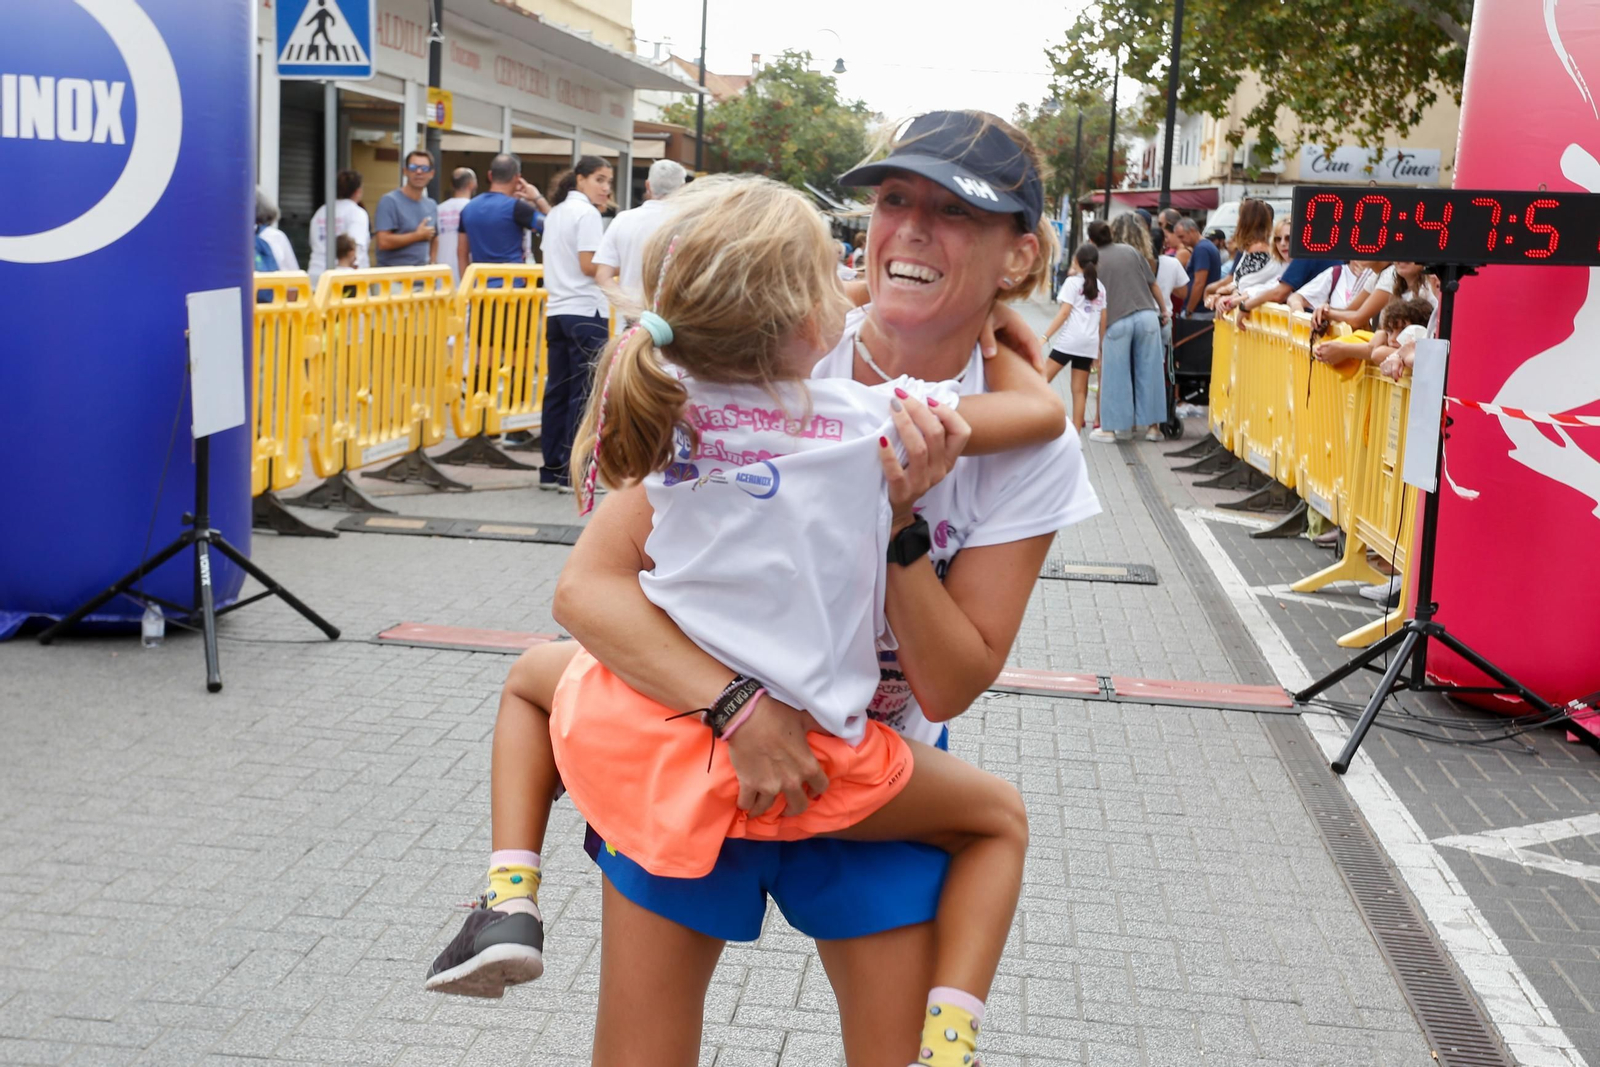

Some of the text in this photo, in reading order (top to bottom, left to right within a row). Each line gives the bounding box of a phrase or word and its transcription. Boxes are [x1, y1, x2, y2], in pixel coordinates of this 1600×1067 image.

[1, 73, 126, 145] INOX
[1311, 153, 1435, 179] Can Tina
[1302, 194, 1600, 258] 00:47:5
[736, 472, 773, 487] ACERINOX
